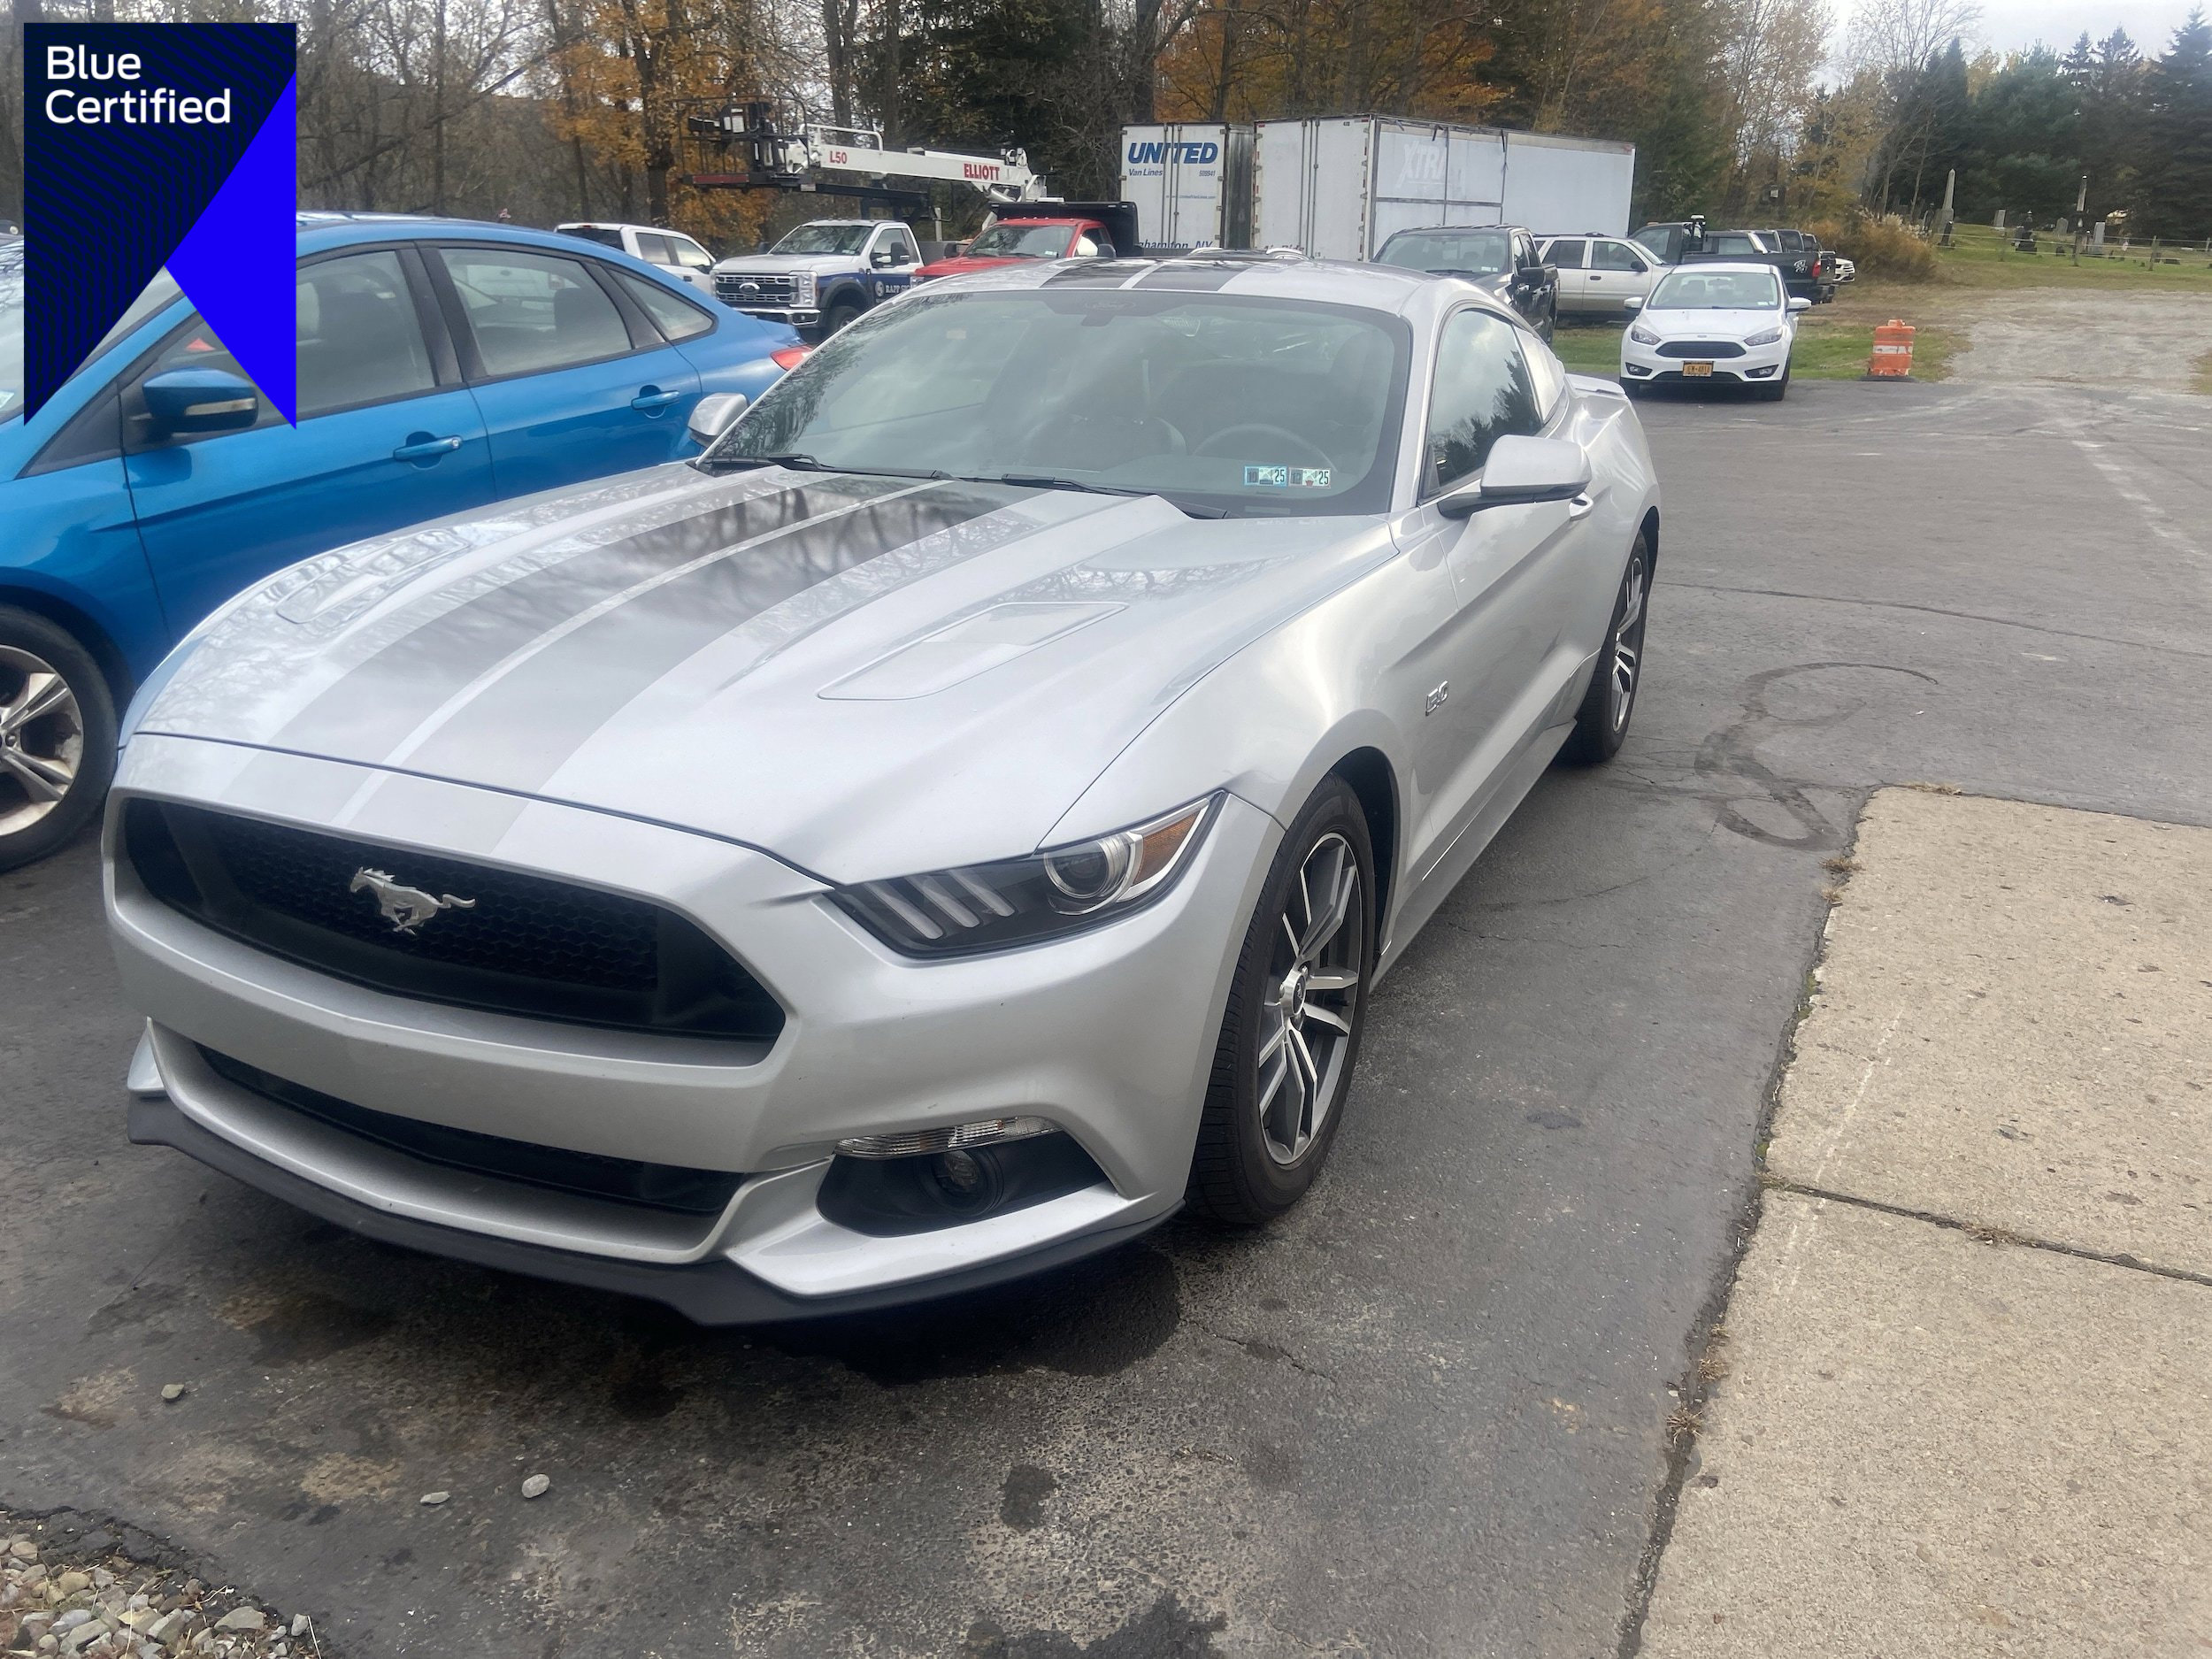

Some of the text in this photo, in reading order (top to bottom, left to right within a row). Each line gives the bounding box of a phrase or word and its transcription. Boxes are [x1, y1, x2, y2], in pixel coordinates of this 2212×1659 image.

[829, 150, 848, 165] L50
[1128, 142, 1218, 165] UNITED
[964, 163, 1000, 180] ELLIOTT
[1274, 470, 1285, 482] 25
[1318, 471, 1329, 484] 25
